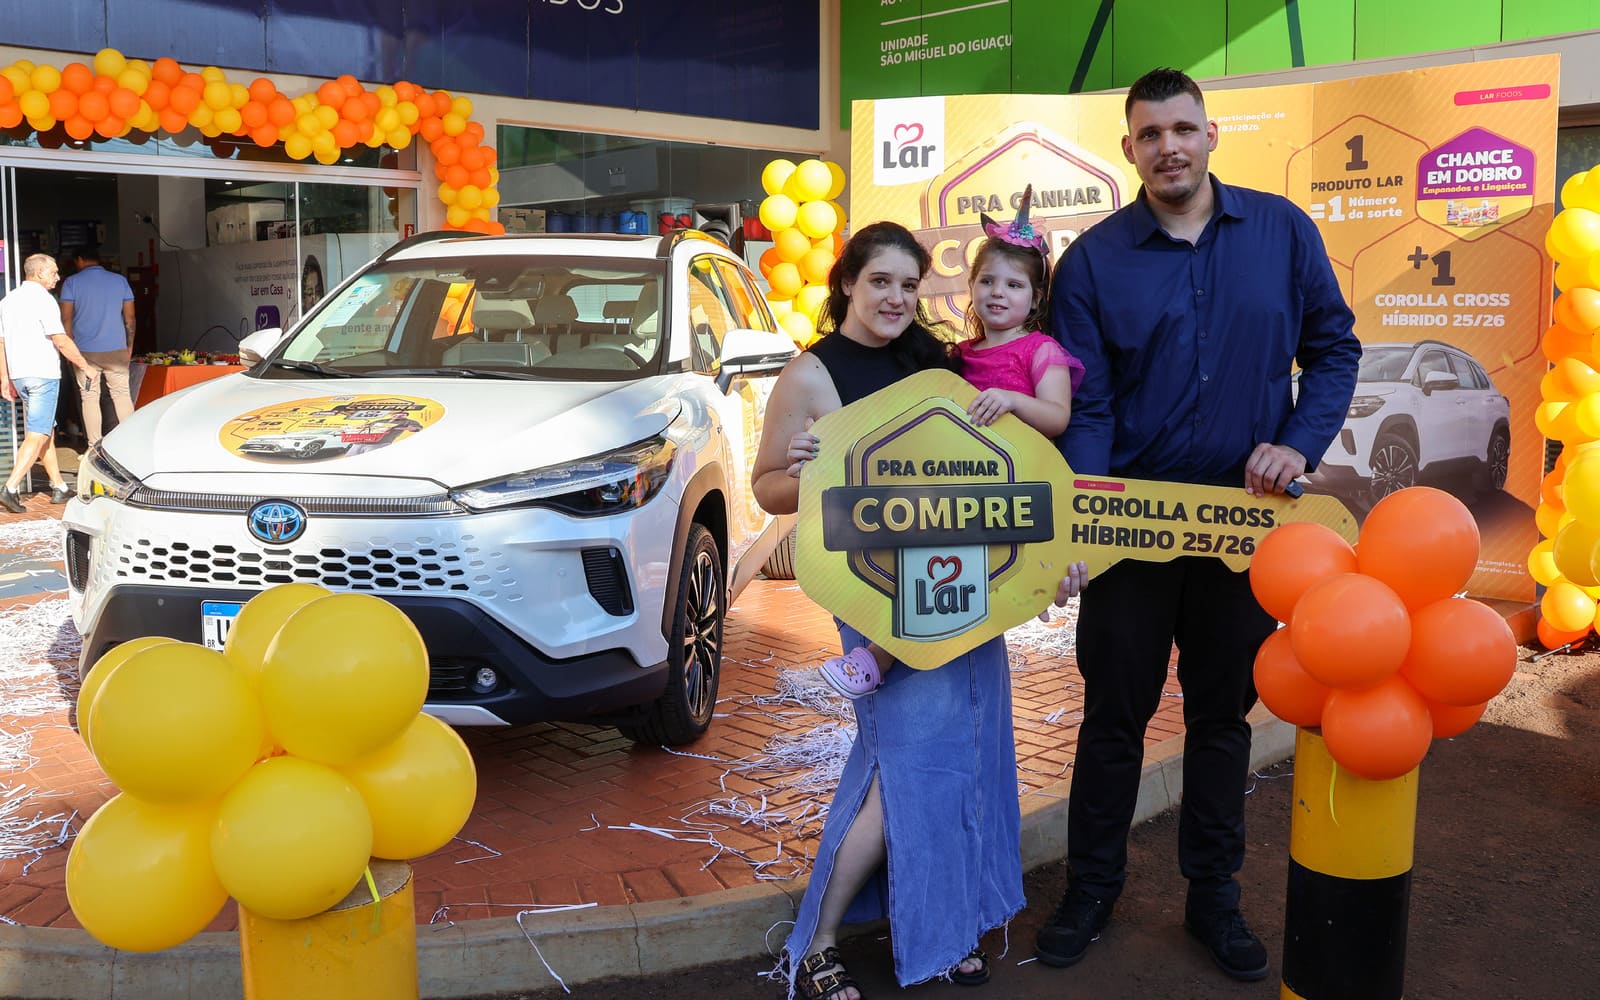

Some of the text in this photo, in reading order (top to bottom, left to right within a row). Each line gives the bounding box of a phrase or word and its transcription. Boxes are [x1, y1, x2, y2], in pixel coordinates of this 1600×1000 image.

[880, 34, 929, 52] UNIDADE
[880, 34, 1013, 66] SÃO MIGUEL DO IGUAÇU
[1495, 91, 1523, 99] FOODS
[882, 141, 936, 169] Lar
[1345, 134, 1369, 172] 1
[1436, 149, 1514, 168] CHANCE
[1310, 175, 1404, 193] PRODUTO LAR
[1427, 165, 1523, 185] EM DOBRO
[1423, 183, 1472, 195] Empanados
[1481, 181, 1528, 193] Linguiças
[957, 186, 1102, 216] PRA GANHAR
[1348, 195, 1398, 208] Número
[1348, 207, 1404, 220] da sorte
[1407, 245, 1456, 287] +1
[1375, 293, 1511, 307] COROLLA CROSS
[1382, 310, 1505, 327] HÍBRIDO 25/26
[876, 459, 1000, 477] PRA GANHAR
[852, 496, 1035, 532] COMPRE
[1072, 494, 1275, 528] COROLLA CROSS
[1071, 518, 1256, 556] HÍBRIDO 25/26
[915, 578, 977, 616] Lar
[207, 639, 216, 648] BR
